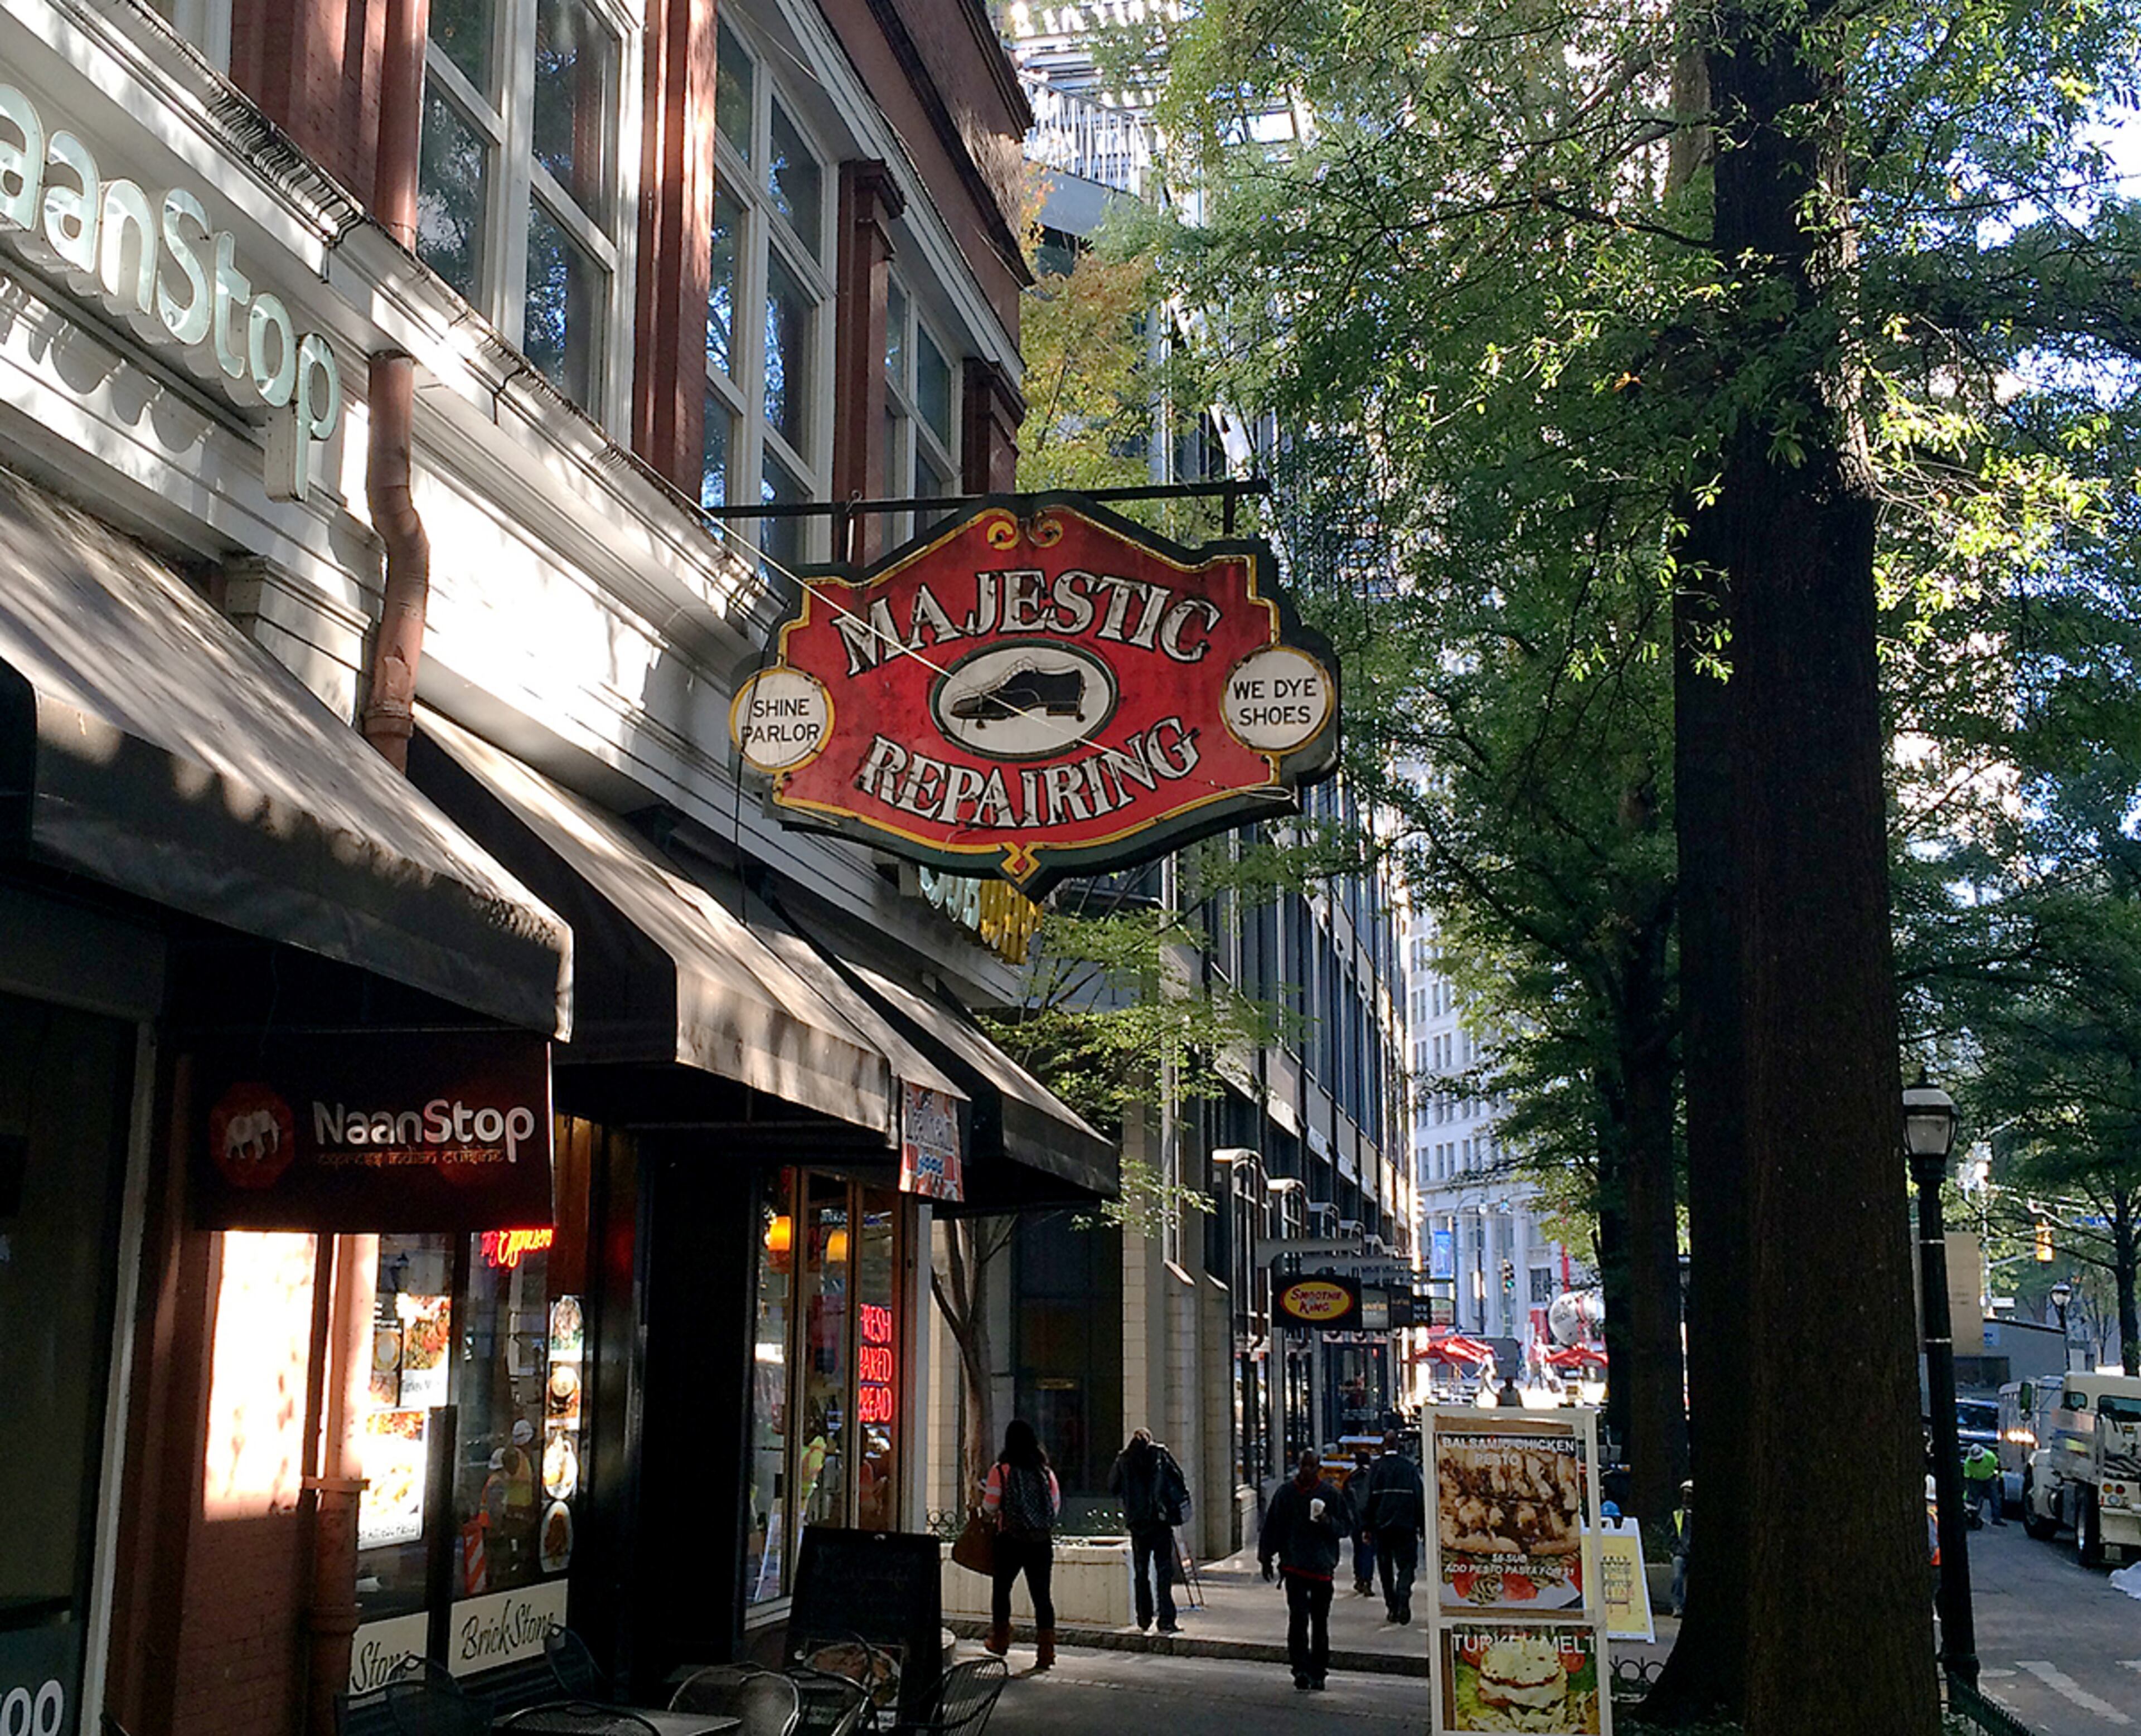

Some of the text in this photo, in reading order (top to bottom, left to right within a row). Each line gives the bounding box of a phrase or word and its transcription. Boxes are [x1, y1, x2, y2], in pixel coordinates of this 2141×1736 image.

[832, 569, 1222, 677] MAJESTIC
[1232, 678, 1316, 699] WE DYE
[753, 699, 810, 717] SHINE
[1239, 706, 1311, 726] SHOES
[742, 724, 820, 743] PARLOR
[858, 716, 1200, 830] REPAIRING
[313, 1098, 535, 1162] NaanStop
[1291, 1288, 1343, 1301] SMOOTHIE
[1299, 1301, 1330, 1314] KING
[1442, 1437, 1575, 1452] BALSAMIC CHICKEN
[1474, 1453, 1520, 1466] PESTO
[1444, 1563, 1467, 1573] ADD
[1469, 1564, 1504, 1574] PESTO
[1505, 1564, 1538, 1575] PASTA
[1539, 1565, 1562, 1576] FOR
[1540, 1635, 1596, 1654] MELT
